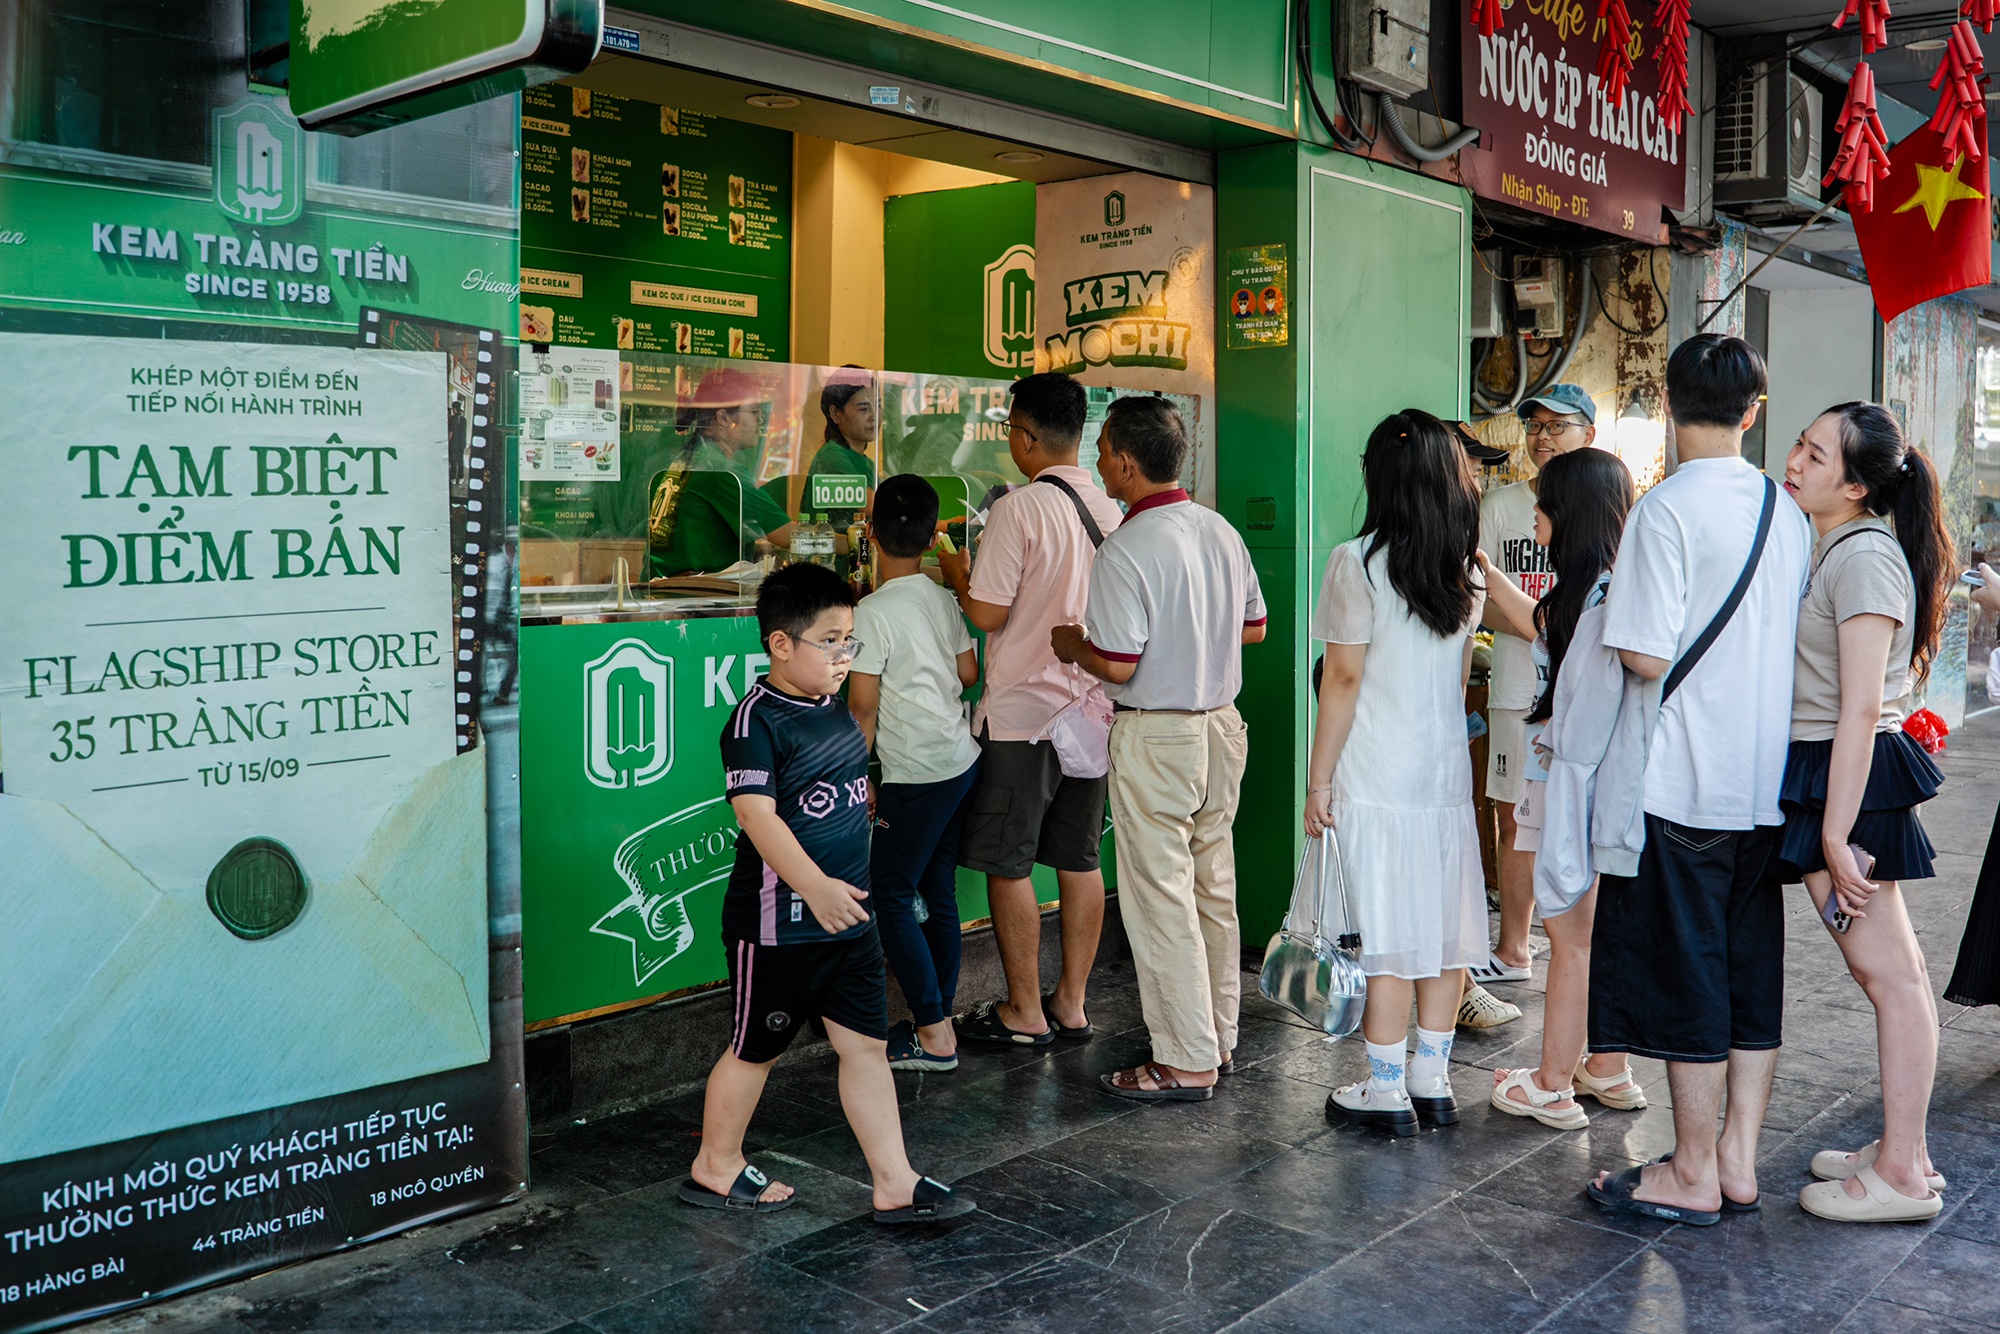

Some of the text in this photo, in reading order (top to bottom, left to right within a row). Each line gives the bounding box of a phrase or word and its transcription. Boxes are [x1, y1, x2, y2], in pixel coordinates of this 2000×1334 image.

[1478, 22, 1549, 119] NƯỚC
[1554, 47, 1582, 130] ÉP
[529, 120, 564, 133] ICE CREAM
[593, 154, 615, 165] KHOAI
[1525, 125, 1608, 188] ĐỒNG GIÁ
[525, 182, 551, 193] CACAO
[682, 170, 708, 181] SOCOLA
[681, 202, 707, 213] SOCOLA
[1502, 173, 1589, 218] Nhận Ship ĐT:
[746, 221, 770, 231] SOCOLA
[1622, 209, 1635, 231] 39
[1080, 234, 1099, 245] KEM
[1101, 227, 1130, 243] TRÀNG
[1099, 239, 1133, 250] SINCE 1958
[92, 222, 408, 283] KEM TRÀNG TIỀN
[186, 273, 331, 305] SINCE 1958
[527, 276, 570, 289] ICE CREAM
[642, 289, 658, 299] KEM
[690, 294, 701, 303] ICE
[703, 295, 727, 306] CREAM
[728, 298, 746, 308] CONE
[1064, 271, 1169, 327] KEM
[636, 322, 651, 331] VANI
[694, 327, 715, 337] CACAO
[1045, 320, 1191, 375] MOCHI
[131, 367, 358, 392] KHÉP MỘT ĐIỂM ĐẾN
[127, 389, 362, 416] TIẾP NỐI HÀNH TRÌNH
[901, 386, 960, 415] KEM
[68, 433, 398, 513] TẠM BIỆT
[555, 487, 582, 495] CACAO
[815, 486, 865, 504] 10.000
[61, 506, 405, 588] ĐIỂM BÁN
[23, 630, 441, 699] FLAGSHIP STORE
[50, 676, 412, 763] 35 TRÀNG TIỀN
[198, 757, 300, 788] TỪ 15/09
[845, 775, 868, 808] XB
[43, 1101, 447, 1213] KÍNH MỜI QUÝ KHÁCH TIẾP TỤC
[6, 1124, 474, 1254] THƯỞNG THỨC KEM TRÀNG TIỀN TẠI:
[370, 1164, 485, 1207] 18 NGÔ QUYỀN
[192, 1206, 325, 1253] 44 TRÀNG TIỀN
[26, 1267, 87, 1298] HÀNG
[92, 1256, 126, 1282] BÀI
